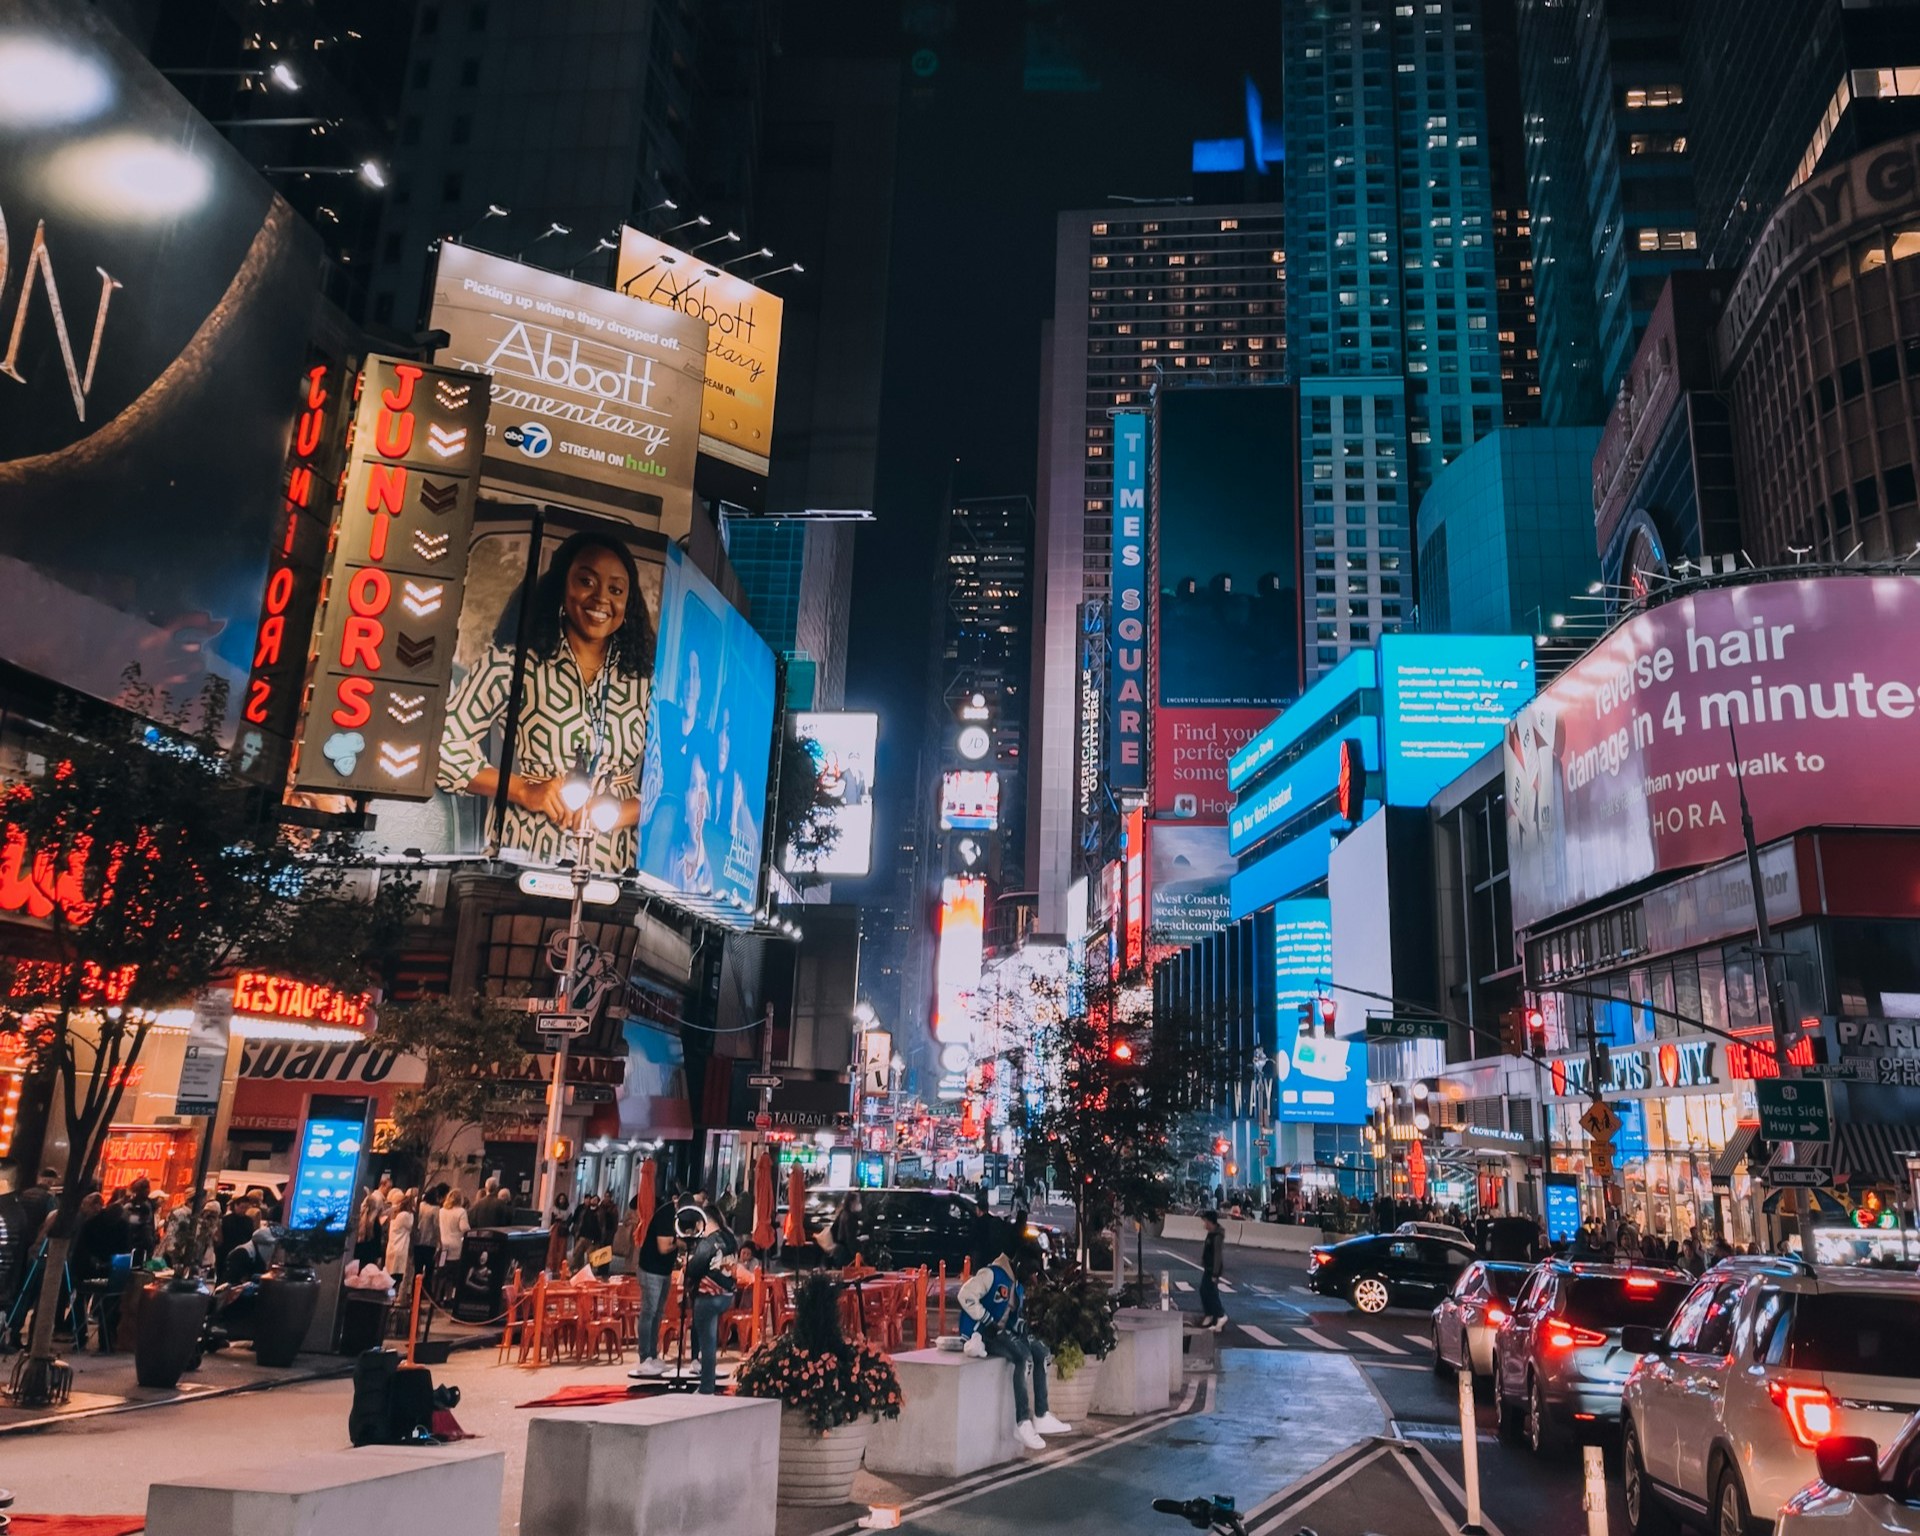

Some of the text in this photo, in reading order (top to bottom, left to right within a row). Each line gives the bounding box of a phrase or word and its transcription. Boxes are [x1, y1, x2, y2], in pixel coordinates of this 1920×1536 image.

[463, 277, 681, 351] Picking up where they dropped off.
[650, 268, 756, 343] Abbott
[483, 321, 656, 407] Abbott
[704, 376, 736, 397] REAM ON
[460, 362, 670, 456] ementary
[504, 431, 525, 443] abc
[559, 441, 605, 463] STREAM
[607, 453, 624, 468] ON
[626, 454, 668, 478] hulu
[1118, 432, 1145, 766] TIMES SQUARE
[1595, 615, 1795, 721] reverse hair
[1081, 669, 1092, 815] AMERICAN EAGLE
[1089, 688, 1099, 792] OUTFITTERS
[1173, 722, 1217, 741] Find
[1567, 727, 1629, 793] damage
[1631, 707, 1654, 751] in
[1662, 690, 1686, 737] 4
[1644, 773, 1672, 797] than
[1675, 762, 1721, 792] your
[1727, 752, 1789, 778] walk
[1794, 750, 1825, 773] to
[1202, 798, 1237, 813] Hote
[1642, 800, 1727, 838] HORA
[1154, 892, 1182, 904] West
[1184, 893, 1217, 905] Coast
[1155, 906, 1232, 922] seeks easygoi
[541, 1019, 583, 1028] ONE WAY
[1381, 1022, 1434, 1036] W 49 St
[1838, 1022, 1920, 1048] PAR
[1726, 1044, 1750, 1080] THE
[1880, 1072, 1899, 1085] 24
[1783, 1086, 1796, 1098] 9A
[747, 1111, 827, 1126] RSTAURANT
[1762, 1104, 1824, 1118] West Side
[1469, 1126, 1525, 1141] CROWNE PLAZA
[1769, 1120, 1796, 1135] Hwy
[1778, 1173, 1824, 1181] ONE WAY
